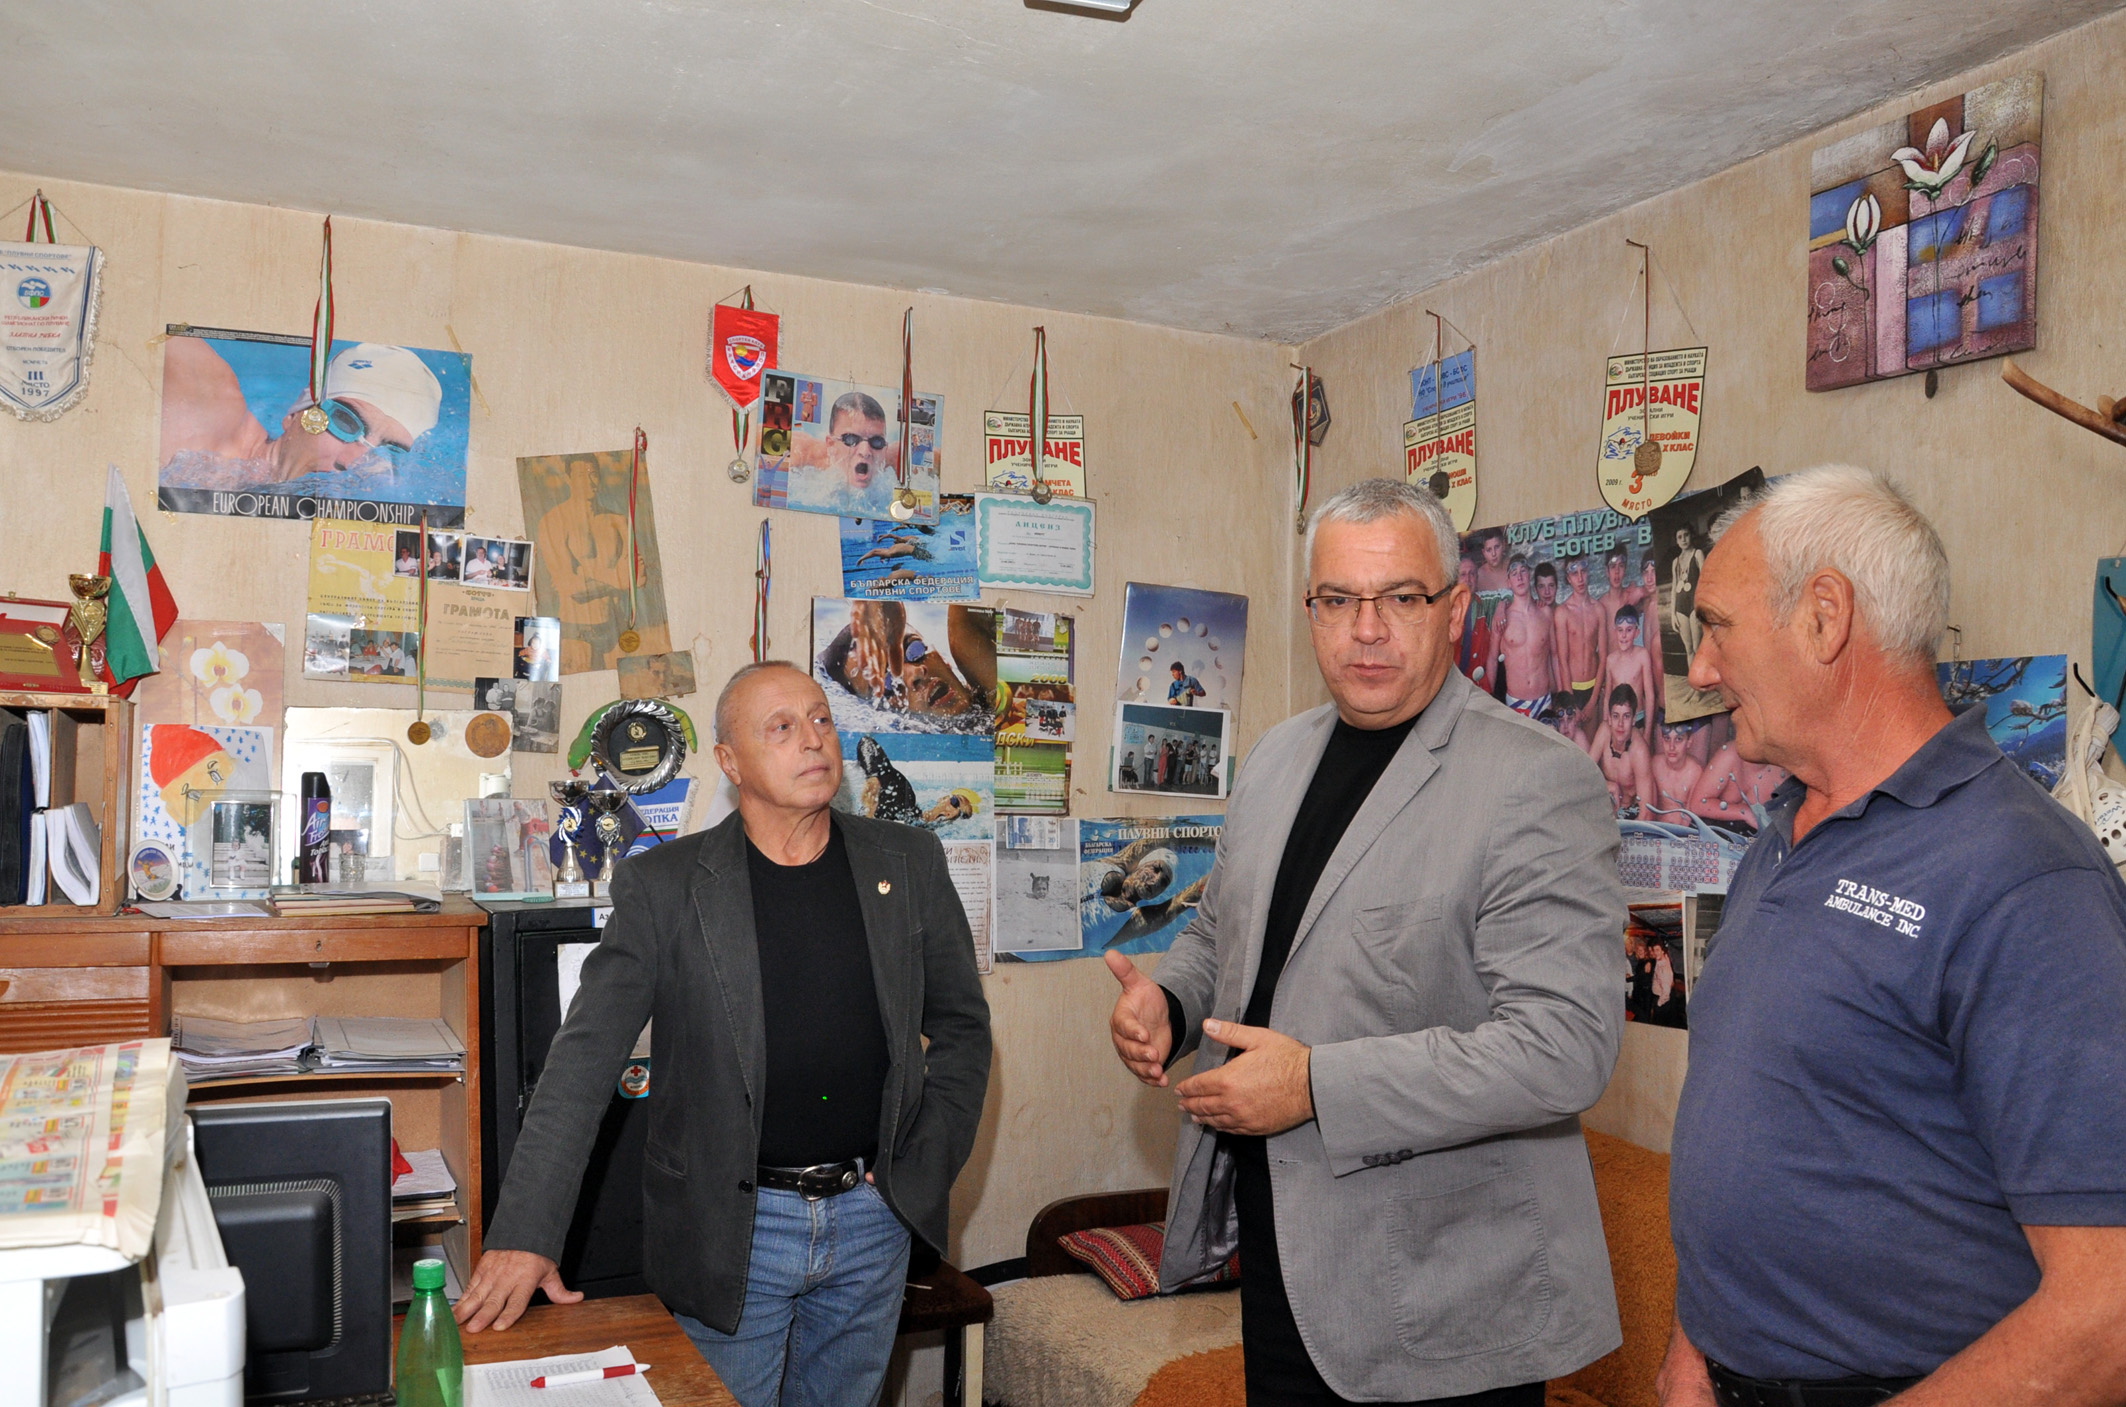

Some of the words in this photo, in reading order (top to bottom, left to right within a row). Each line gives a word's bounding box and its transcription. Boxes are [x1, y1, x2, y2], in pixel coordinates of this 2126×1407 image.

[22, 387, 49, 397] 1997
[1607, 382, 1700, 421] ПЛУВАНЕ
[1407, 429, 1474, 476] ПЛУВАНЕ
[1670, 443, 1694, 452] КЛАС
[1032, 479, 1071, 487] ММЧЕТА
[1628, 468, 1645, 494] 3
[212, 491, 289, 516] EUROPEAN
[296, 497, 415, 524] CHAMPIONSHIP
[1622, 498, 1652, 511] МЯСТО
[1015, 521, 1061, 531] ЛИЦЕНЗ
[1507, 519, 1556, 545] КЛУБ
[1553, 532, 1615, 559] БОТЕВ
[850, 578, 911, 588] БЪЛГАРСКА
[913, 576, 974, 586] ФЕДЕРАЦИЯ
[865, 588, 906, 597] ПЛУВНИ
[909, 585, 961, 595] СПОРТОВЕ
[443, 603, 510, 620] ГРАМОТА
[301, 812, 326, 836] Air
[1118, 827, 1170, 840] ПЛУВНИ
[1835, 879, 1926, 921] TRANS-MED
[1824, 894, 1894, 927] AMBULANCE
